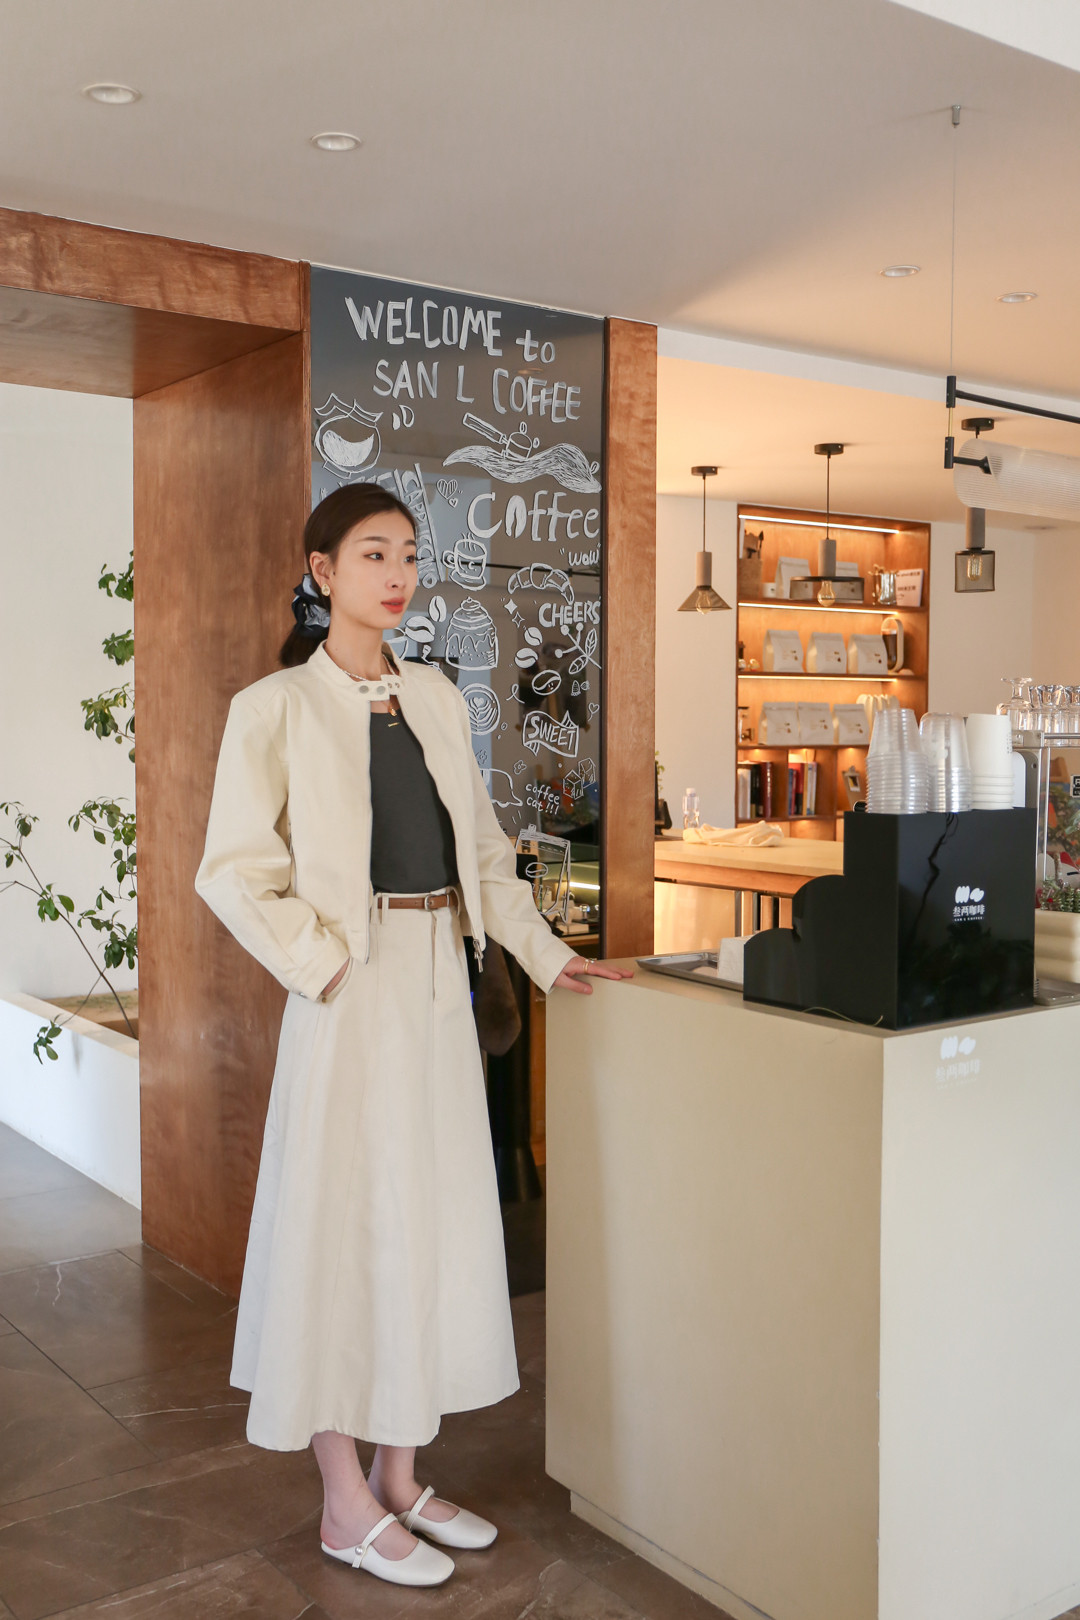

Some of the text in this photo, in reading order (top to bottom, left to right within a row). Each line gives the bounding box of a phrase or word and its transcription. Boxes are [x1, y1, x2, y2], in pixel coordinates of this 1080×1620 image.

[345, 297, 556, 363] WELCOME to
[373, 359, 581, 423] SAN L COFFEE
[539, 601, 600, 627] CHEERS
[528, 715, 576, 750] SWEET
[526, 783, 560, 805] coffee
